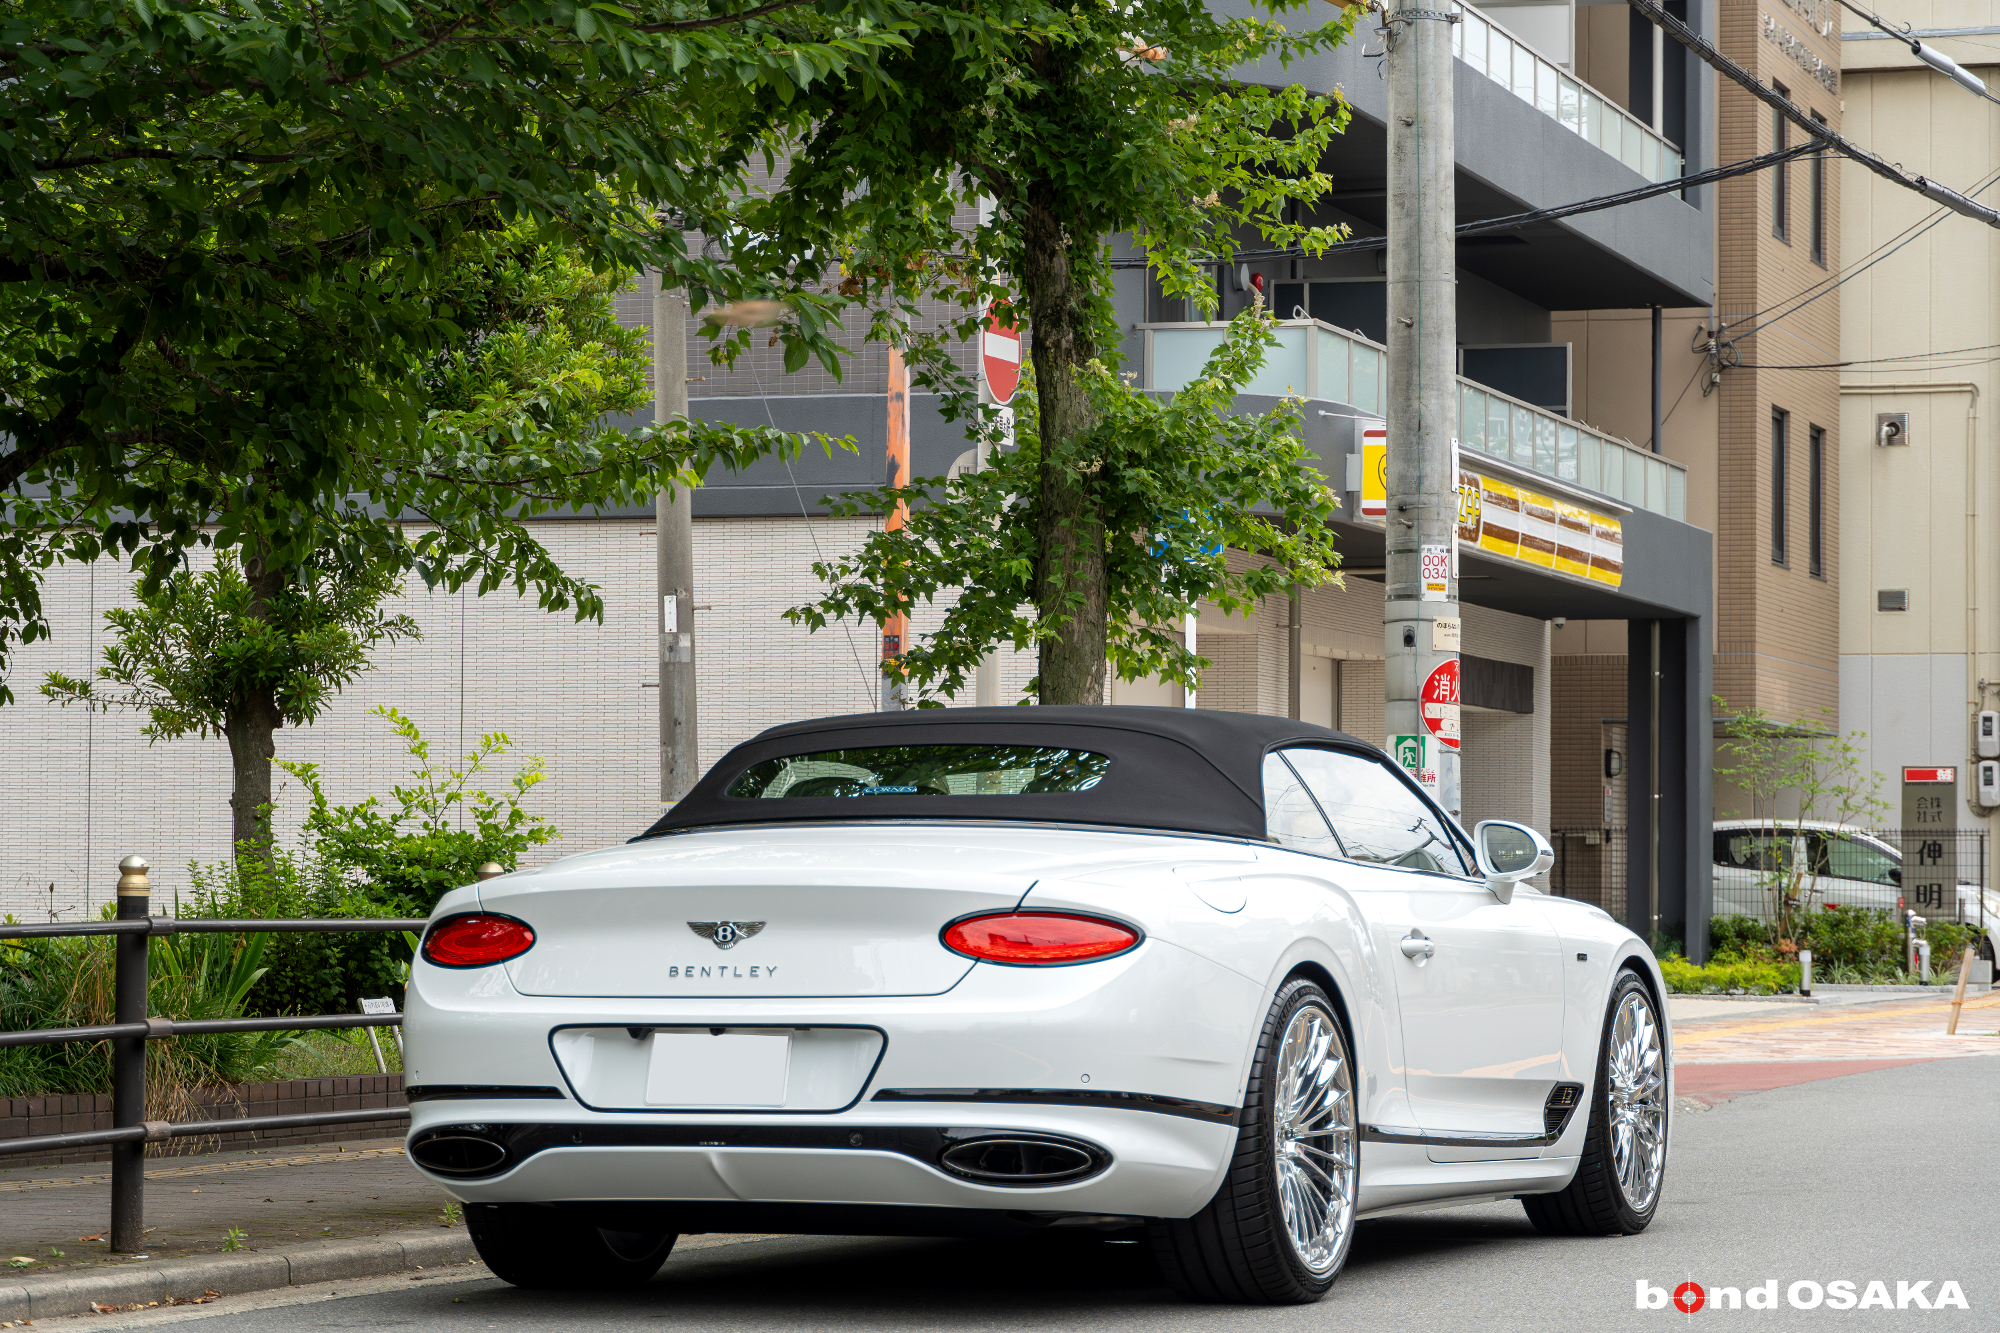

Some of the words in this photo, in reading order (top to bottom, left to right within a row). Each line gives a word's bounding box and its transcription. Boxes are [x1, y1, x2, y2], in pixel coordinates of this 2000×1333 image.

[1422, 567, 1447, 580] 034
[1915, 840, 1942, 910] 伸明
[669, 965, 778, 978] BENTLEY
